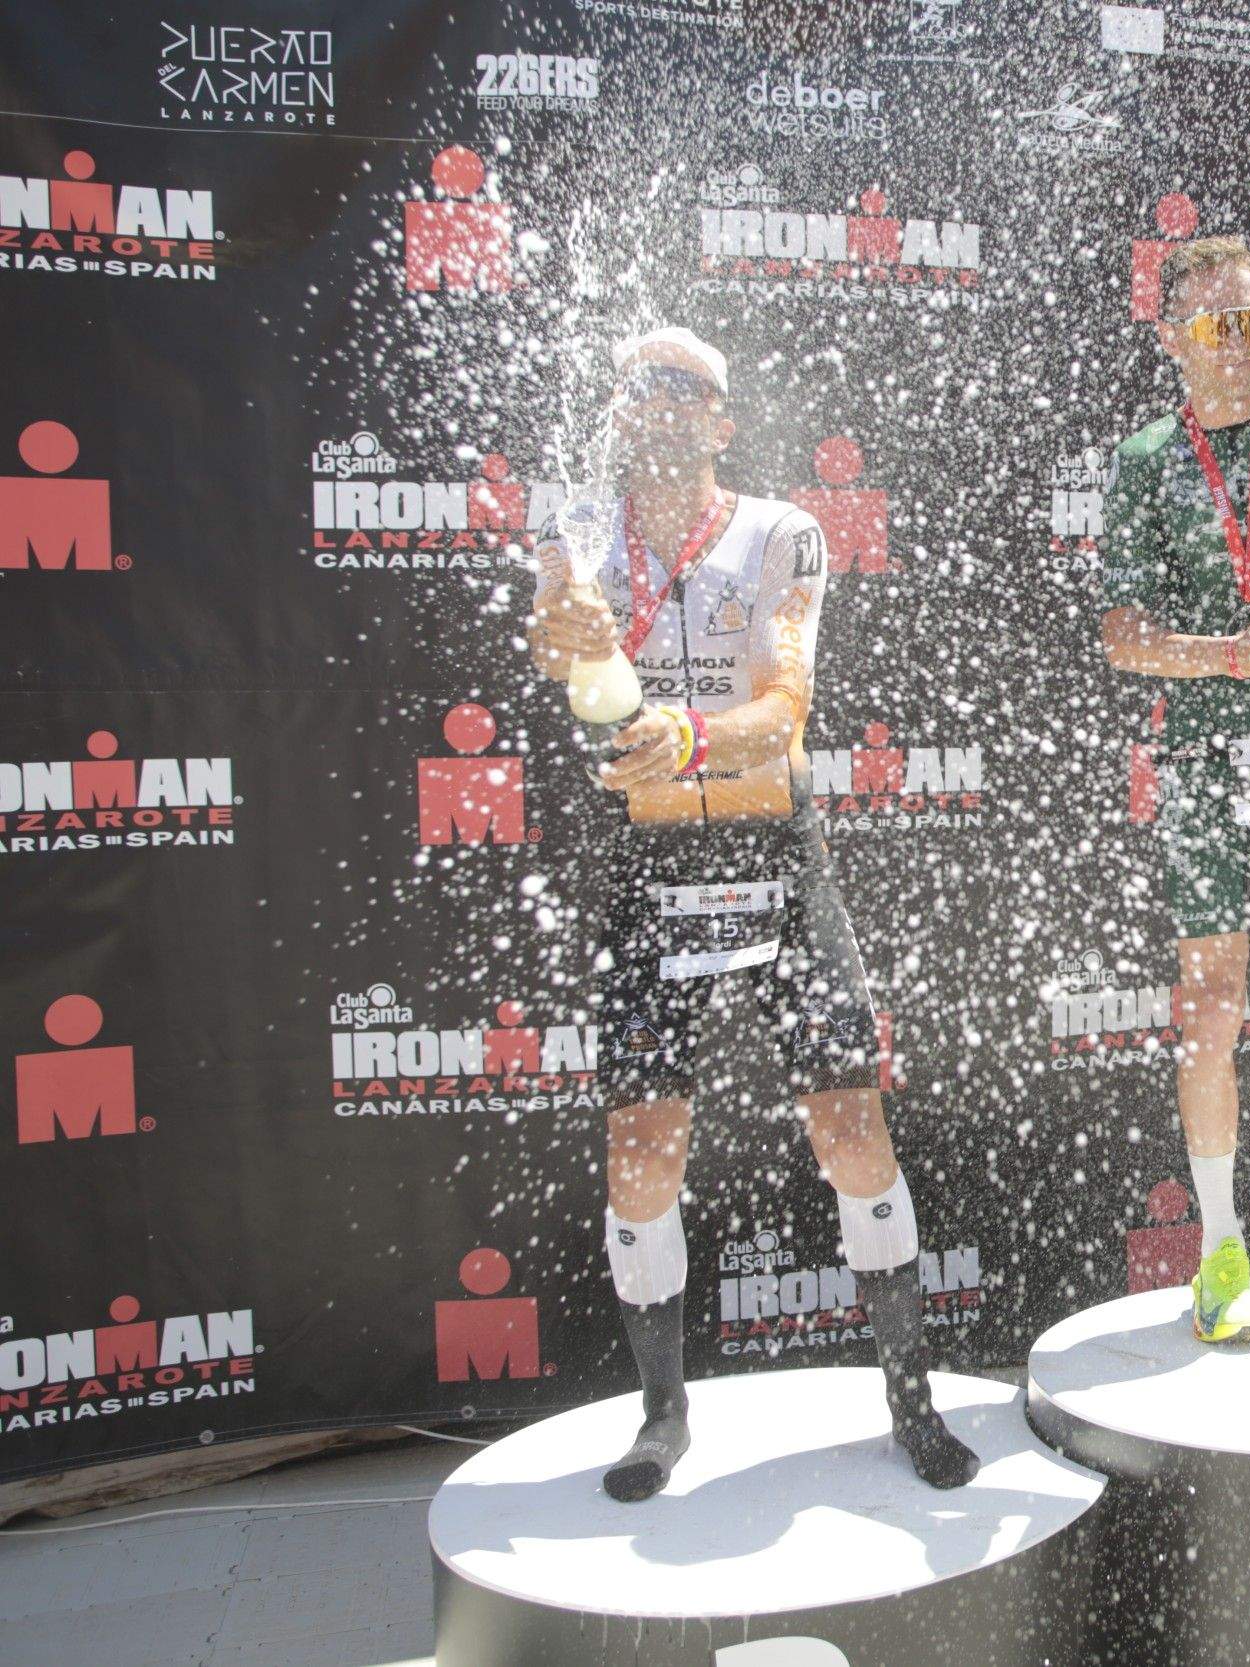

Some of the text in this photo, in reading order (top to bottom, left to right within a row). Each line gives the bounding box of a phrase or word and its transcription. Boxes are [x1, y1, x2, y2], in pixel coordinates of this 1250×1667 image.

[576, 0, 744, 28] SPORTS DESTINATION
[158, 63, 177, 76] DEL
[476, 54, 600, 98] 226ERS
[160, 68, 334, 107] CARMEN
[746, 70, 886, 112] deboer
[477, 96, 507, 110] FEED
[161, 108, 336, 125] LANZAROTE
[701, 209, 981, 268] IRONMAN
[104, 259, 216, 281] SPAIN
[701, 280, 867, 300] CANARIAS
[319, 440, 351, 456] Club
[313, 451, 396, 479] LaSanta
[313, 481, 568, 530] IRONMA
[315, 553, 492, 569] CANARIAS
[0, 808, 233, 832] ZAROTE
[895, 813, 982, 829] SPAIN
[126, 830, 234, 847] SPAIN
[709, 918, 739, 938] 15
[1058, 961, 1081, 972] Club
[336, 993, 369, 1008] Club
[330, 1004, 413, 1029] LaSanta
[332, 1026, 597, 1079] IRONMA
[333, 1073, 596, 1098] LANZAROT
[334, 1094, 604, 1117] CANARIAS SPAI
[724, 1240, 753, 1256] Club
[719, 1250, 795, 1274] LaSanta
[722, 1324, 875, 1355] CANARIAS
[148, 1378, 256, 1406] SPAIN
